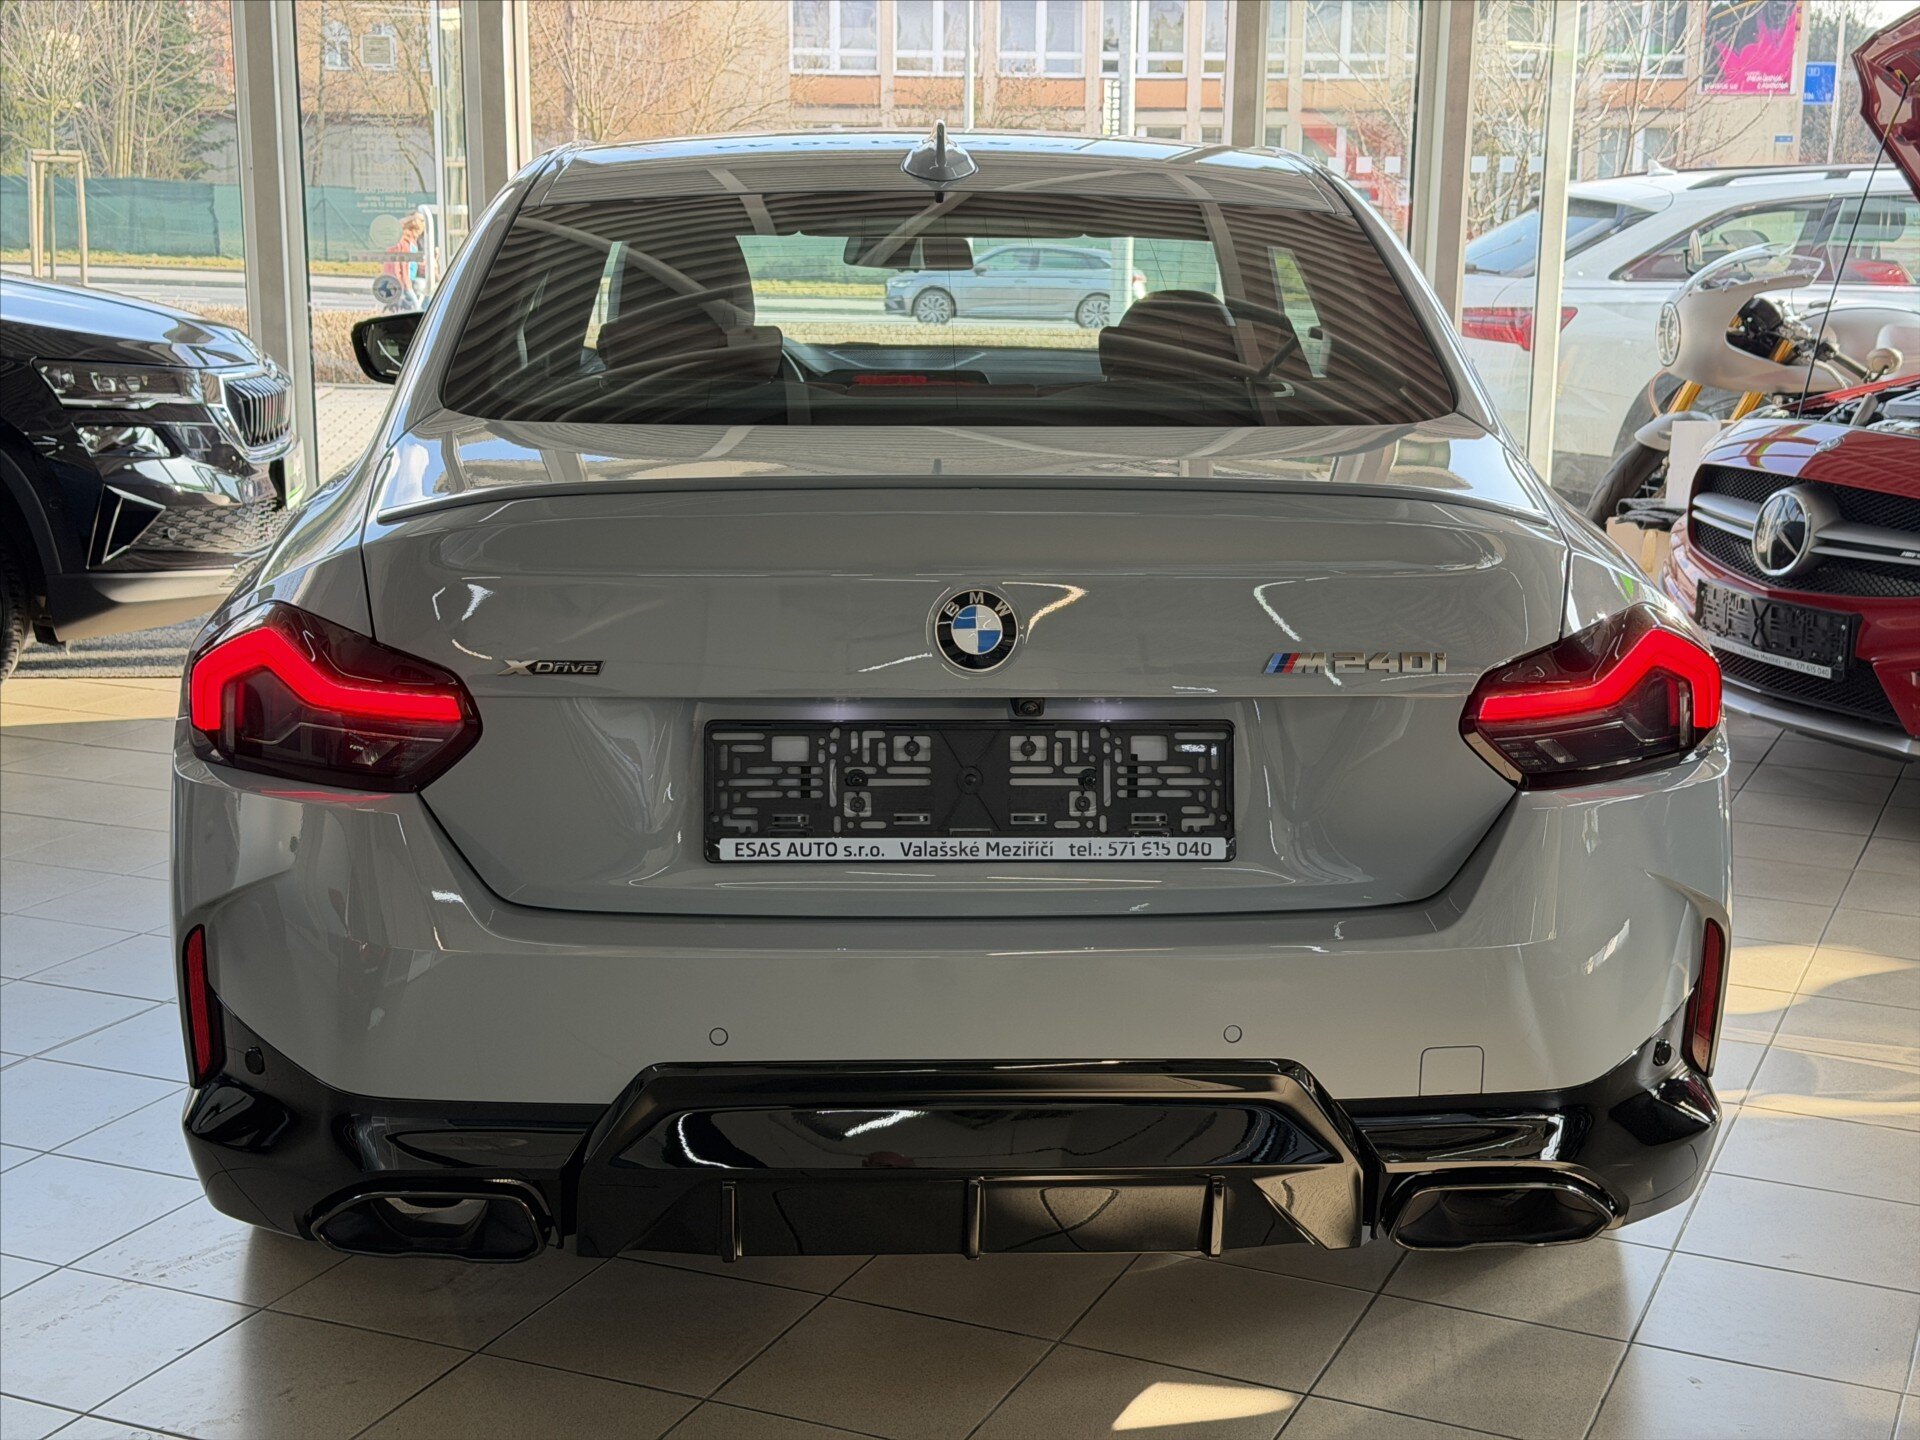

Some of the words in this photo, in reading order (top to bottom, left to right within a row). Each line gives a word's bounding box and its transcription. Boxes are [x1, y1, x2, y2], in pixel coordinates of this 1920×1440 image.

[943, 591, 1011, 617] BMW
[1291, 651, 1447, 674] M240i
[734, 842, 781, 858] ESAS
[786, 842, 838, 858] AUTO
[843, 844, 885, 858] s.r.o.
[900, 840, 979, 858] Valašské
[986, 840, 1054, 857] Meziříčí
[1069, 841, 1102, 857] tel.:
[1108, 842, 1136, 857] 571
[1177, 842, 1212, 857] 040
